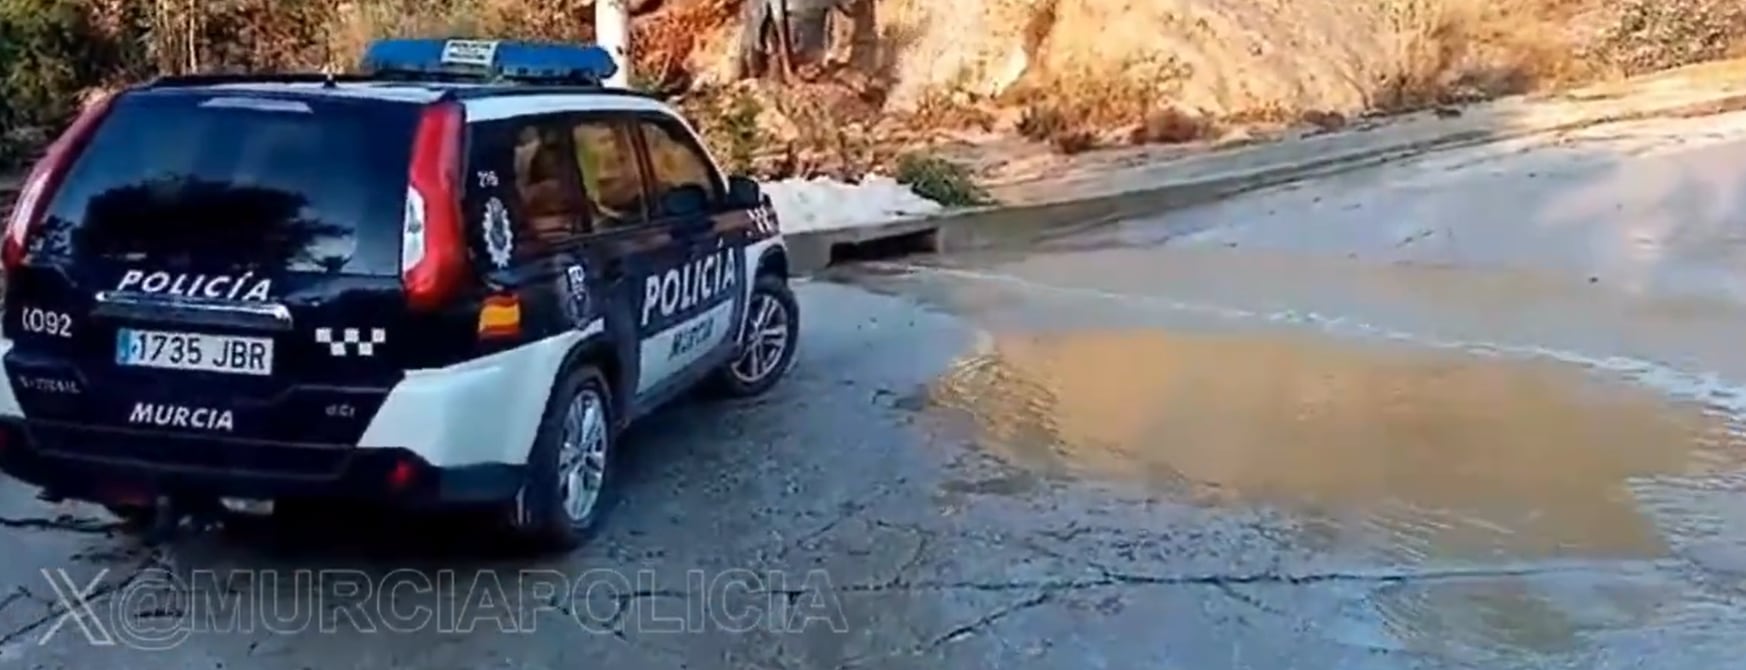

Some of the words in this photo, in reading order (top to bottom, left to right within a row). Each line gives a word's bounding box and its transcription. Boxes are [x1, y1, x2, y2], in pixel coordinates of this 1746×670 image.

[117, 270, 272, 301] POLICÍA
[641, 237, 735, 326] POLICÍA
[139, 334, 202, 365] 1735
[212, 341, 266, 369] JBR
[129, 402, 235, 431] MURCIA
